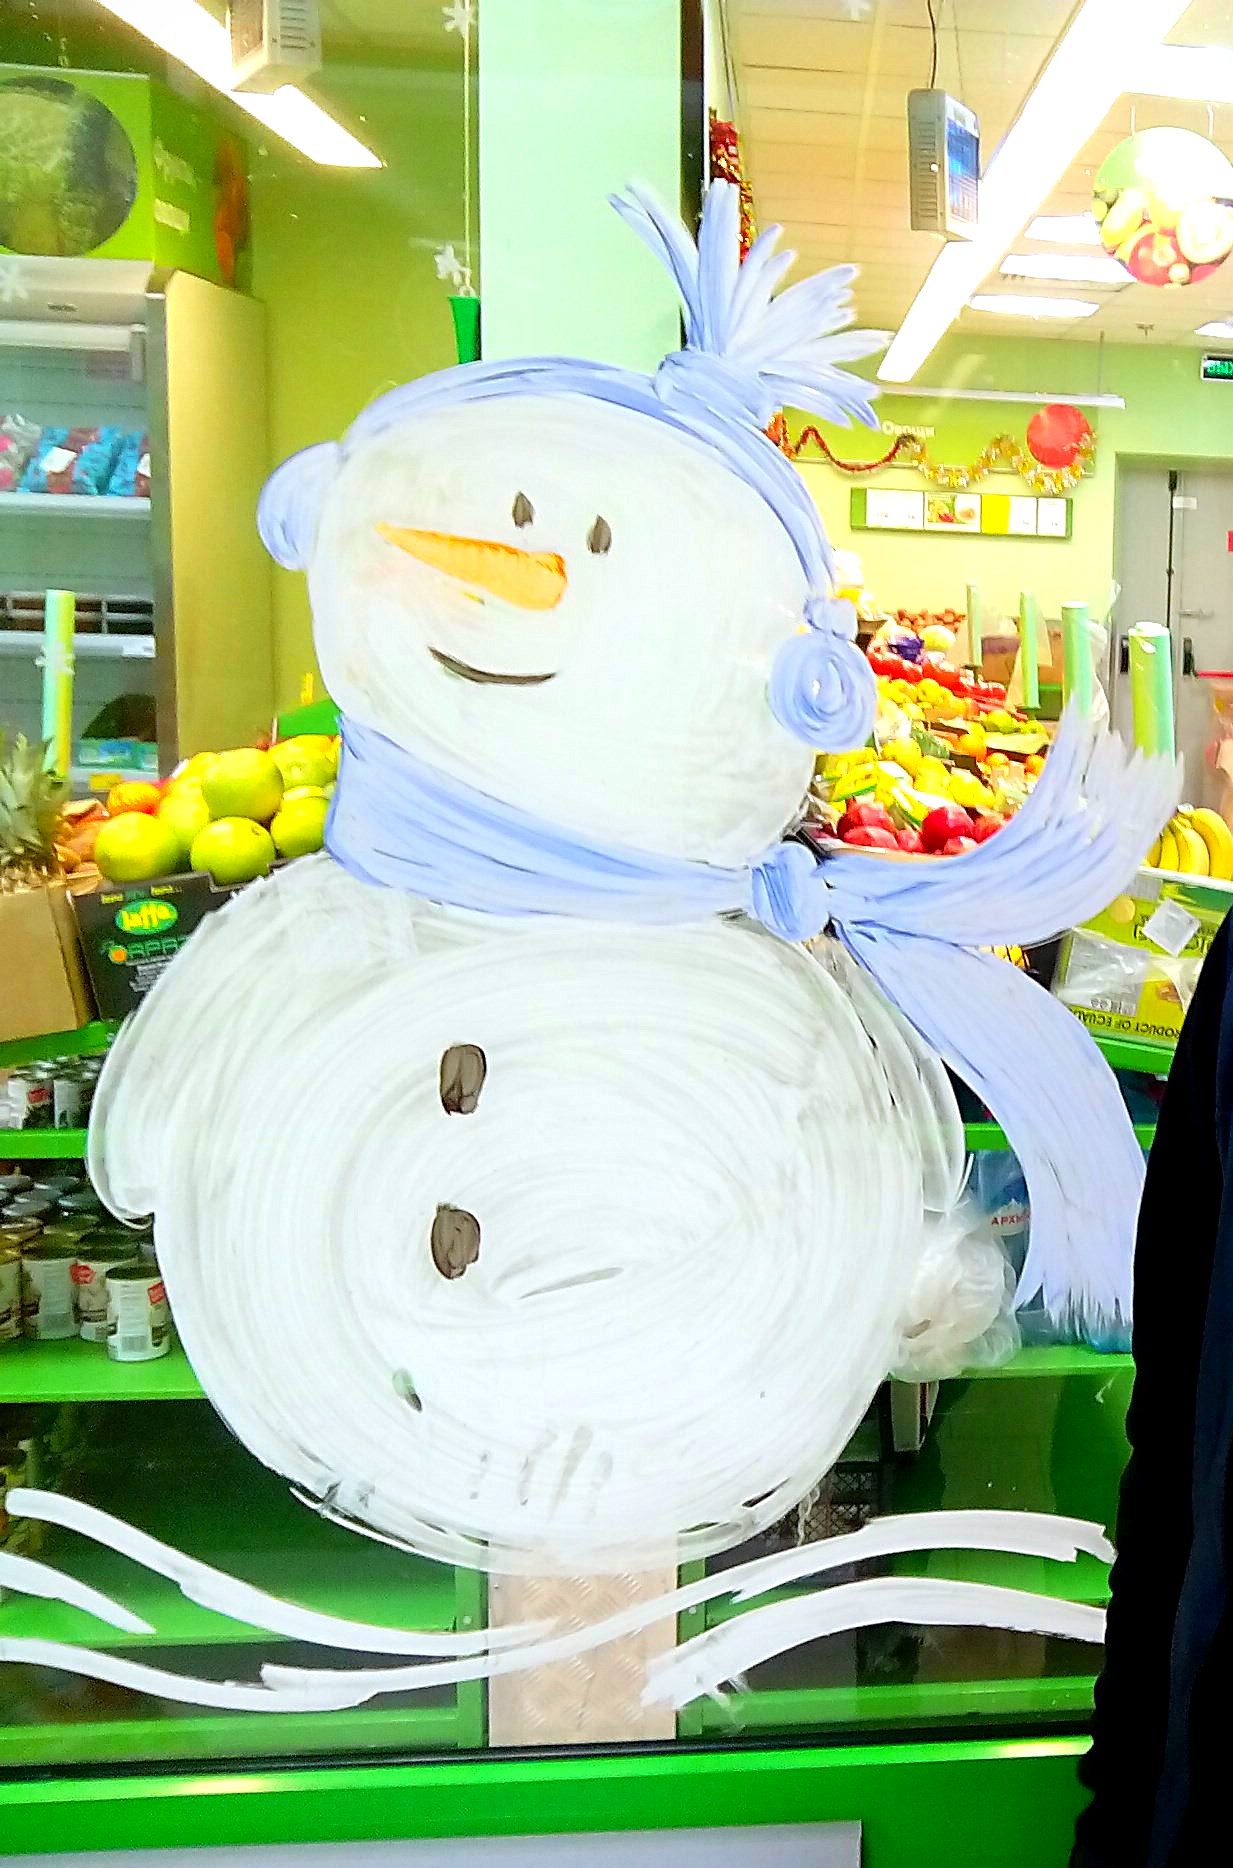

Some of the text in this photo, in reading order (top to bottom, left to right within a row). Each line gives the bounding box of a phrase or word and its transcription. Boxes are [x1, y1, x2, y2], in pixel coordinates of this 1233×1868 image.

[881, 420, 935, 439] Овощи
[1076, 1009, 1181, 1039] RODUCT OF ECUAD
